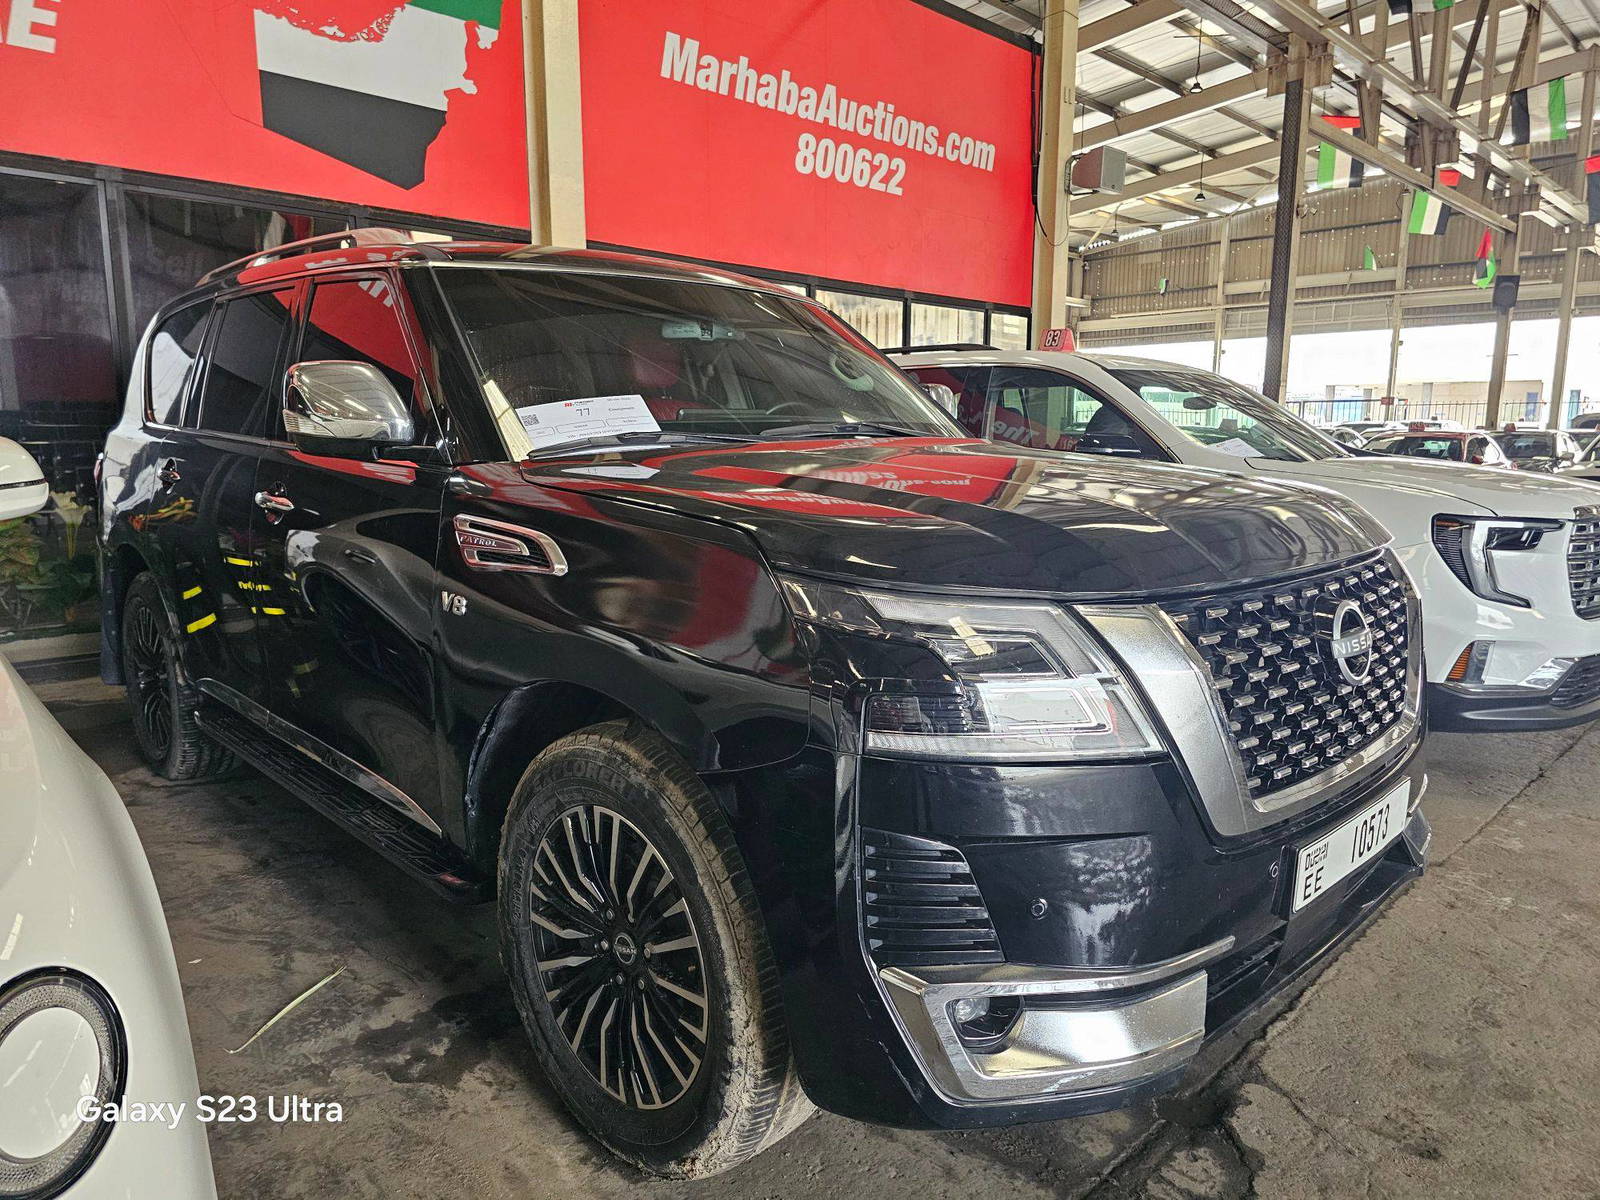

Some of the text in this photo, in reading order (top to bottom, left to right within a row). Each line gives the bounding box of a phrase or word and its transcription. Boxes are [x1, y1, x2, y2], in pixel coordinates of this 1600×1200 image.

[660, 31, 996, 172] MarhabaAuctions.com
[795, 133, 906, 196] 800622
[1045, 330, 1061, 347] 83
[575, 407, 591, 417] 77
[460, 535, 497, 547] PATROL
[441, 590, 467, 616] V8
[1351, 803, 1390, 864] 10573
[1303, 866, 1324, 901] EE
